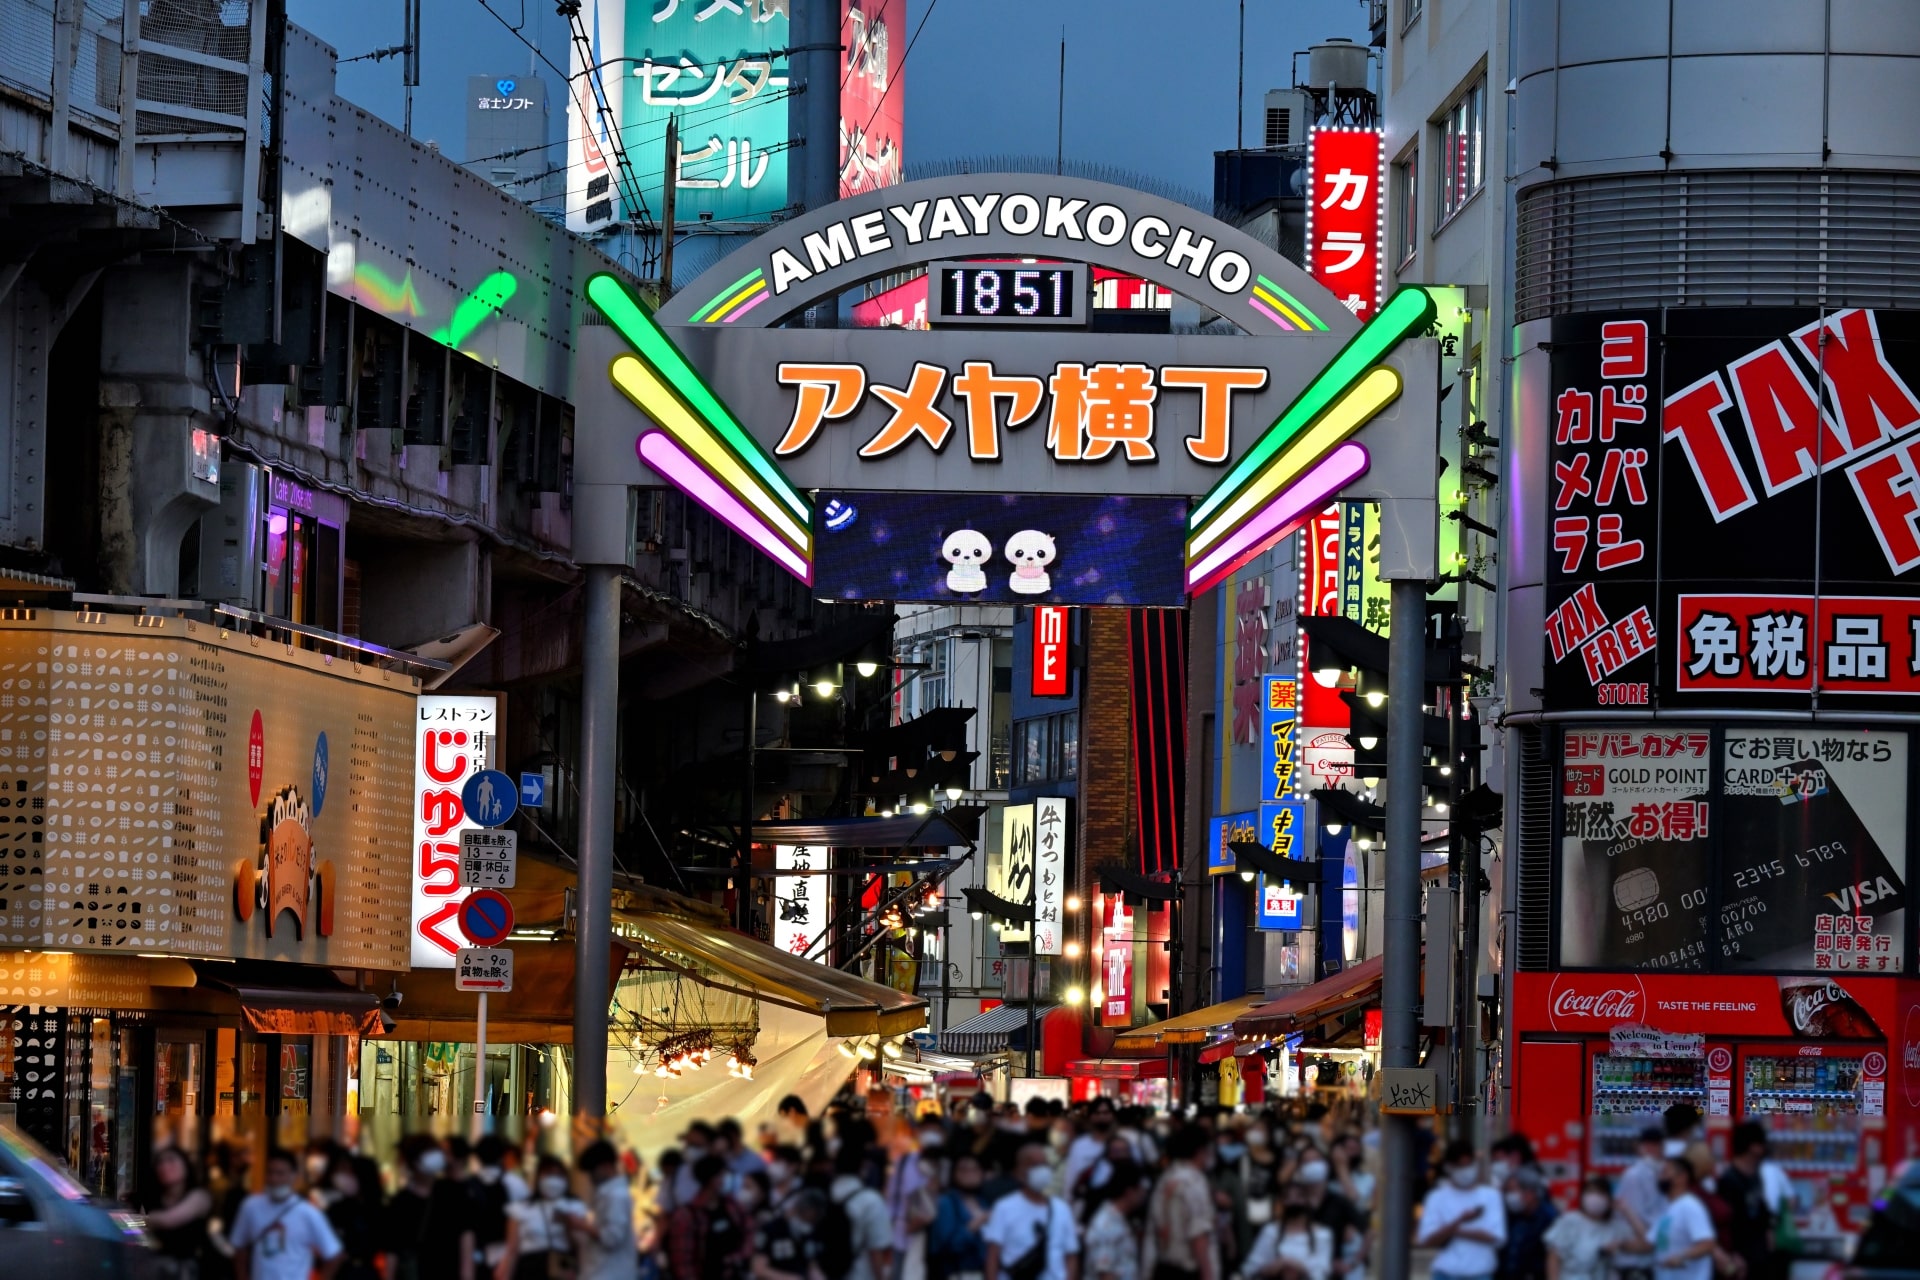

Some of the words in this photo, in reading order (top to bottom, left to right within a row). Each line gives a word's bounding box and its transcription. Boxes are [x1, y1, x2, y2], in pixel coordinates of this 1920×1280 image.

[478, 97, 534, 110] 富士ソフト
[675, 137, 770, 189] ビル
[771, 193, 1253, 295] AMEYAYOKOCHO
[775, 361, 1268, 463] アメヤ横丁
[1663, 308, 1920, 524] TAX
[1595, 320, 1649, 571] ヨドバシ
[1554, 388, 1593, 573] カメラ
[1347, 507, 1361, 620] トラベル用品
[1545, 583, 1609, 664] TAX
[1580, 605, 1656, 686] FREE
[1688, 613, 1920, 678] 免税品
[1598, 683, 1649, 705] STORE
[421, 707, 493, 722] レストラン
[1564, 733, 1709, 758] ヨドバシカメラ
[1725, 737, 1892, 762] でお買い物なら
[1566, 768, 1600, 782] 他カード
[1608, 768, 1650, 784] GOLD
[1655, 768, 1707, 784] POINT
[1724, 769, 1774, 785] CARD
[1574, 783, 1590, 794] より
[464, 834, 512, 846] 自転車を除く
[1606, 838, 1637, 857] GOLD
[467, 847, 480, 858] 13
[499, 848, 507, 859] 6
[466, 871, 480, 883] 12
[498, 873, 506, 884] 6
[1622, 901, 1669, 931] 4980
[1733, 858, 1786, 889] 2345
[1795, 840, 1847, 868] 6789
[1823, 876, 1899, 912] VISA
[1270, 900, 1291, 911] 免税
[1721, 901, 1767, 925] 00/00
[1721, 920, 1755, 941] ARO
[1815, 914, 1873, 933] 店内で
[1625, 931, 1645, 945] 4980
[1815, 934, 1891, 951] 即時発行
[463, 953, 472, 965] 6
[461, 965, 509, 978] 貨物を除く
[1553, 988, 1641, 1019] Coca-Cola
[1657, 1001, 1689, 1010] TASTE
[1692, 1001, 1711, 1011] THE
[1713, 1002, 1756, 1011] FEELING
[1615, 1030, 1661, 1042] Welcome
